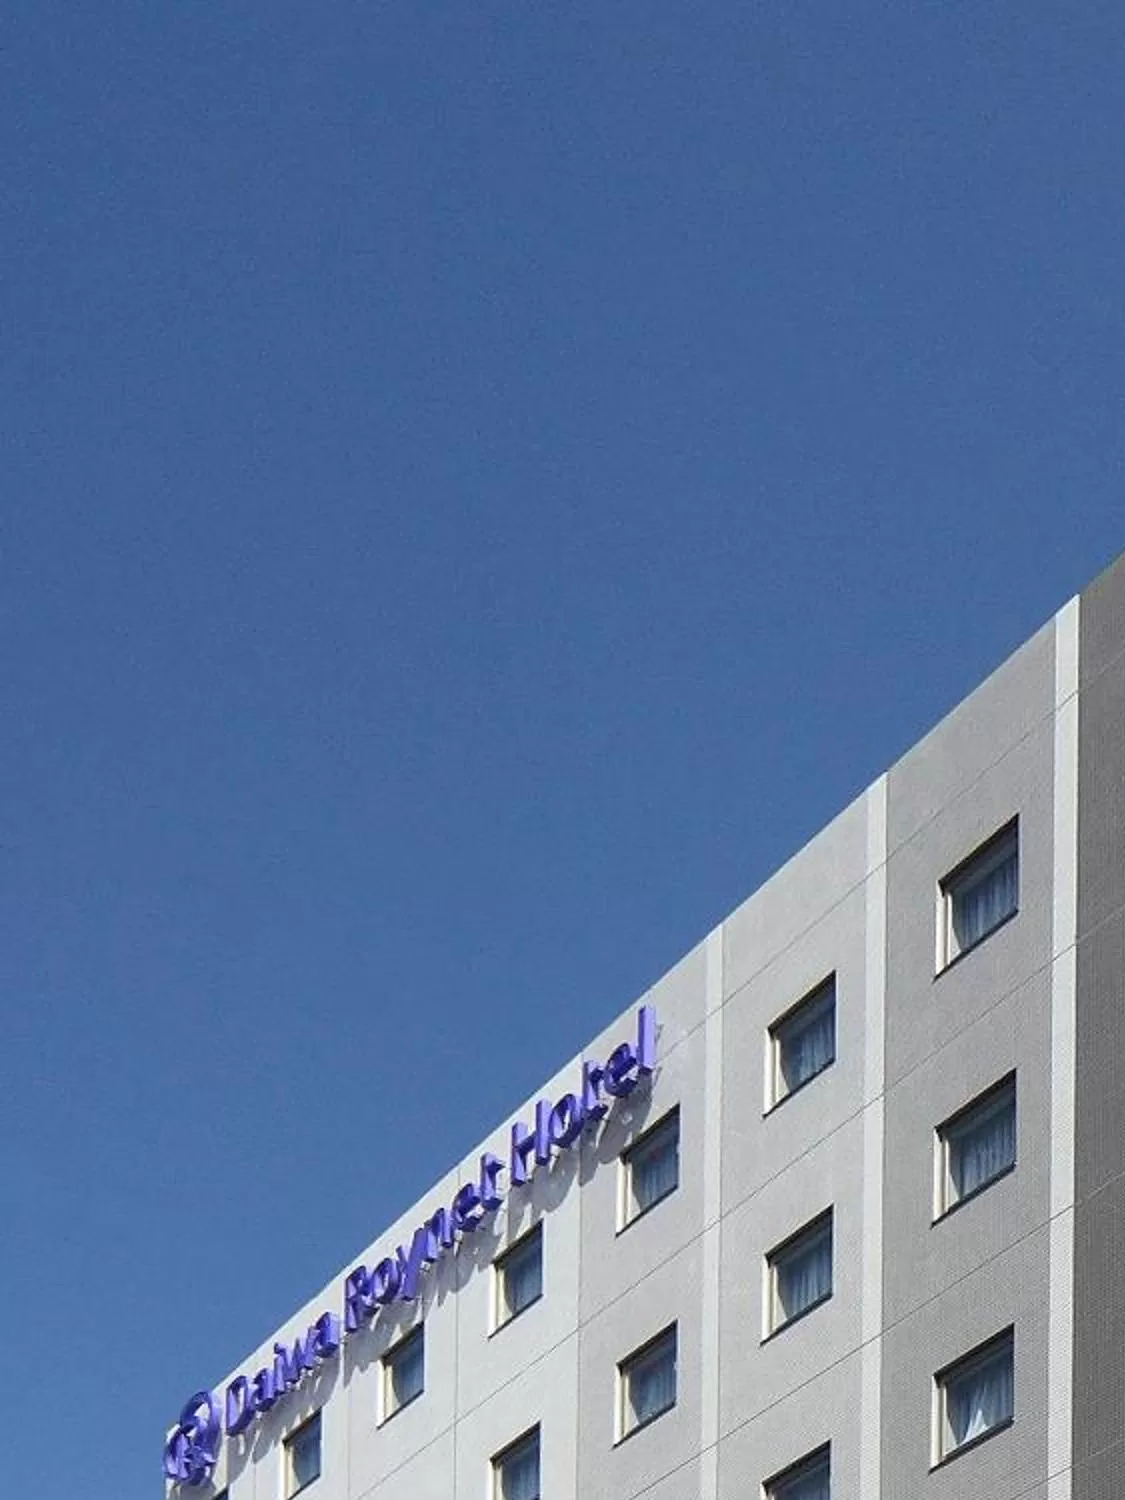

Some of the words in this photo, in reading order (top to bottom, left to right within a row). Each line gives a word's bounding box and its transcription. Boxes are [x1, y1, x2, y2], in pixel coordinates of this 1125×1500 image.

[226, 1312, 339, 1436] Daiwa
[345, 1153, 505, 1332] Roynet
[511, 1004, 657, 1186] Hotel
